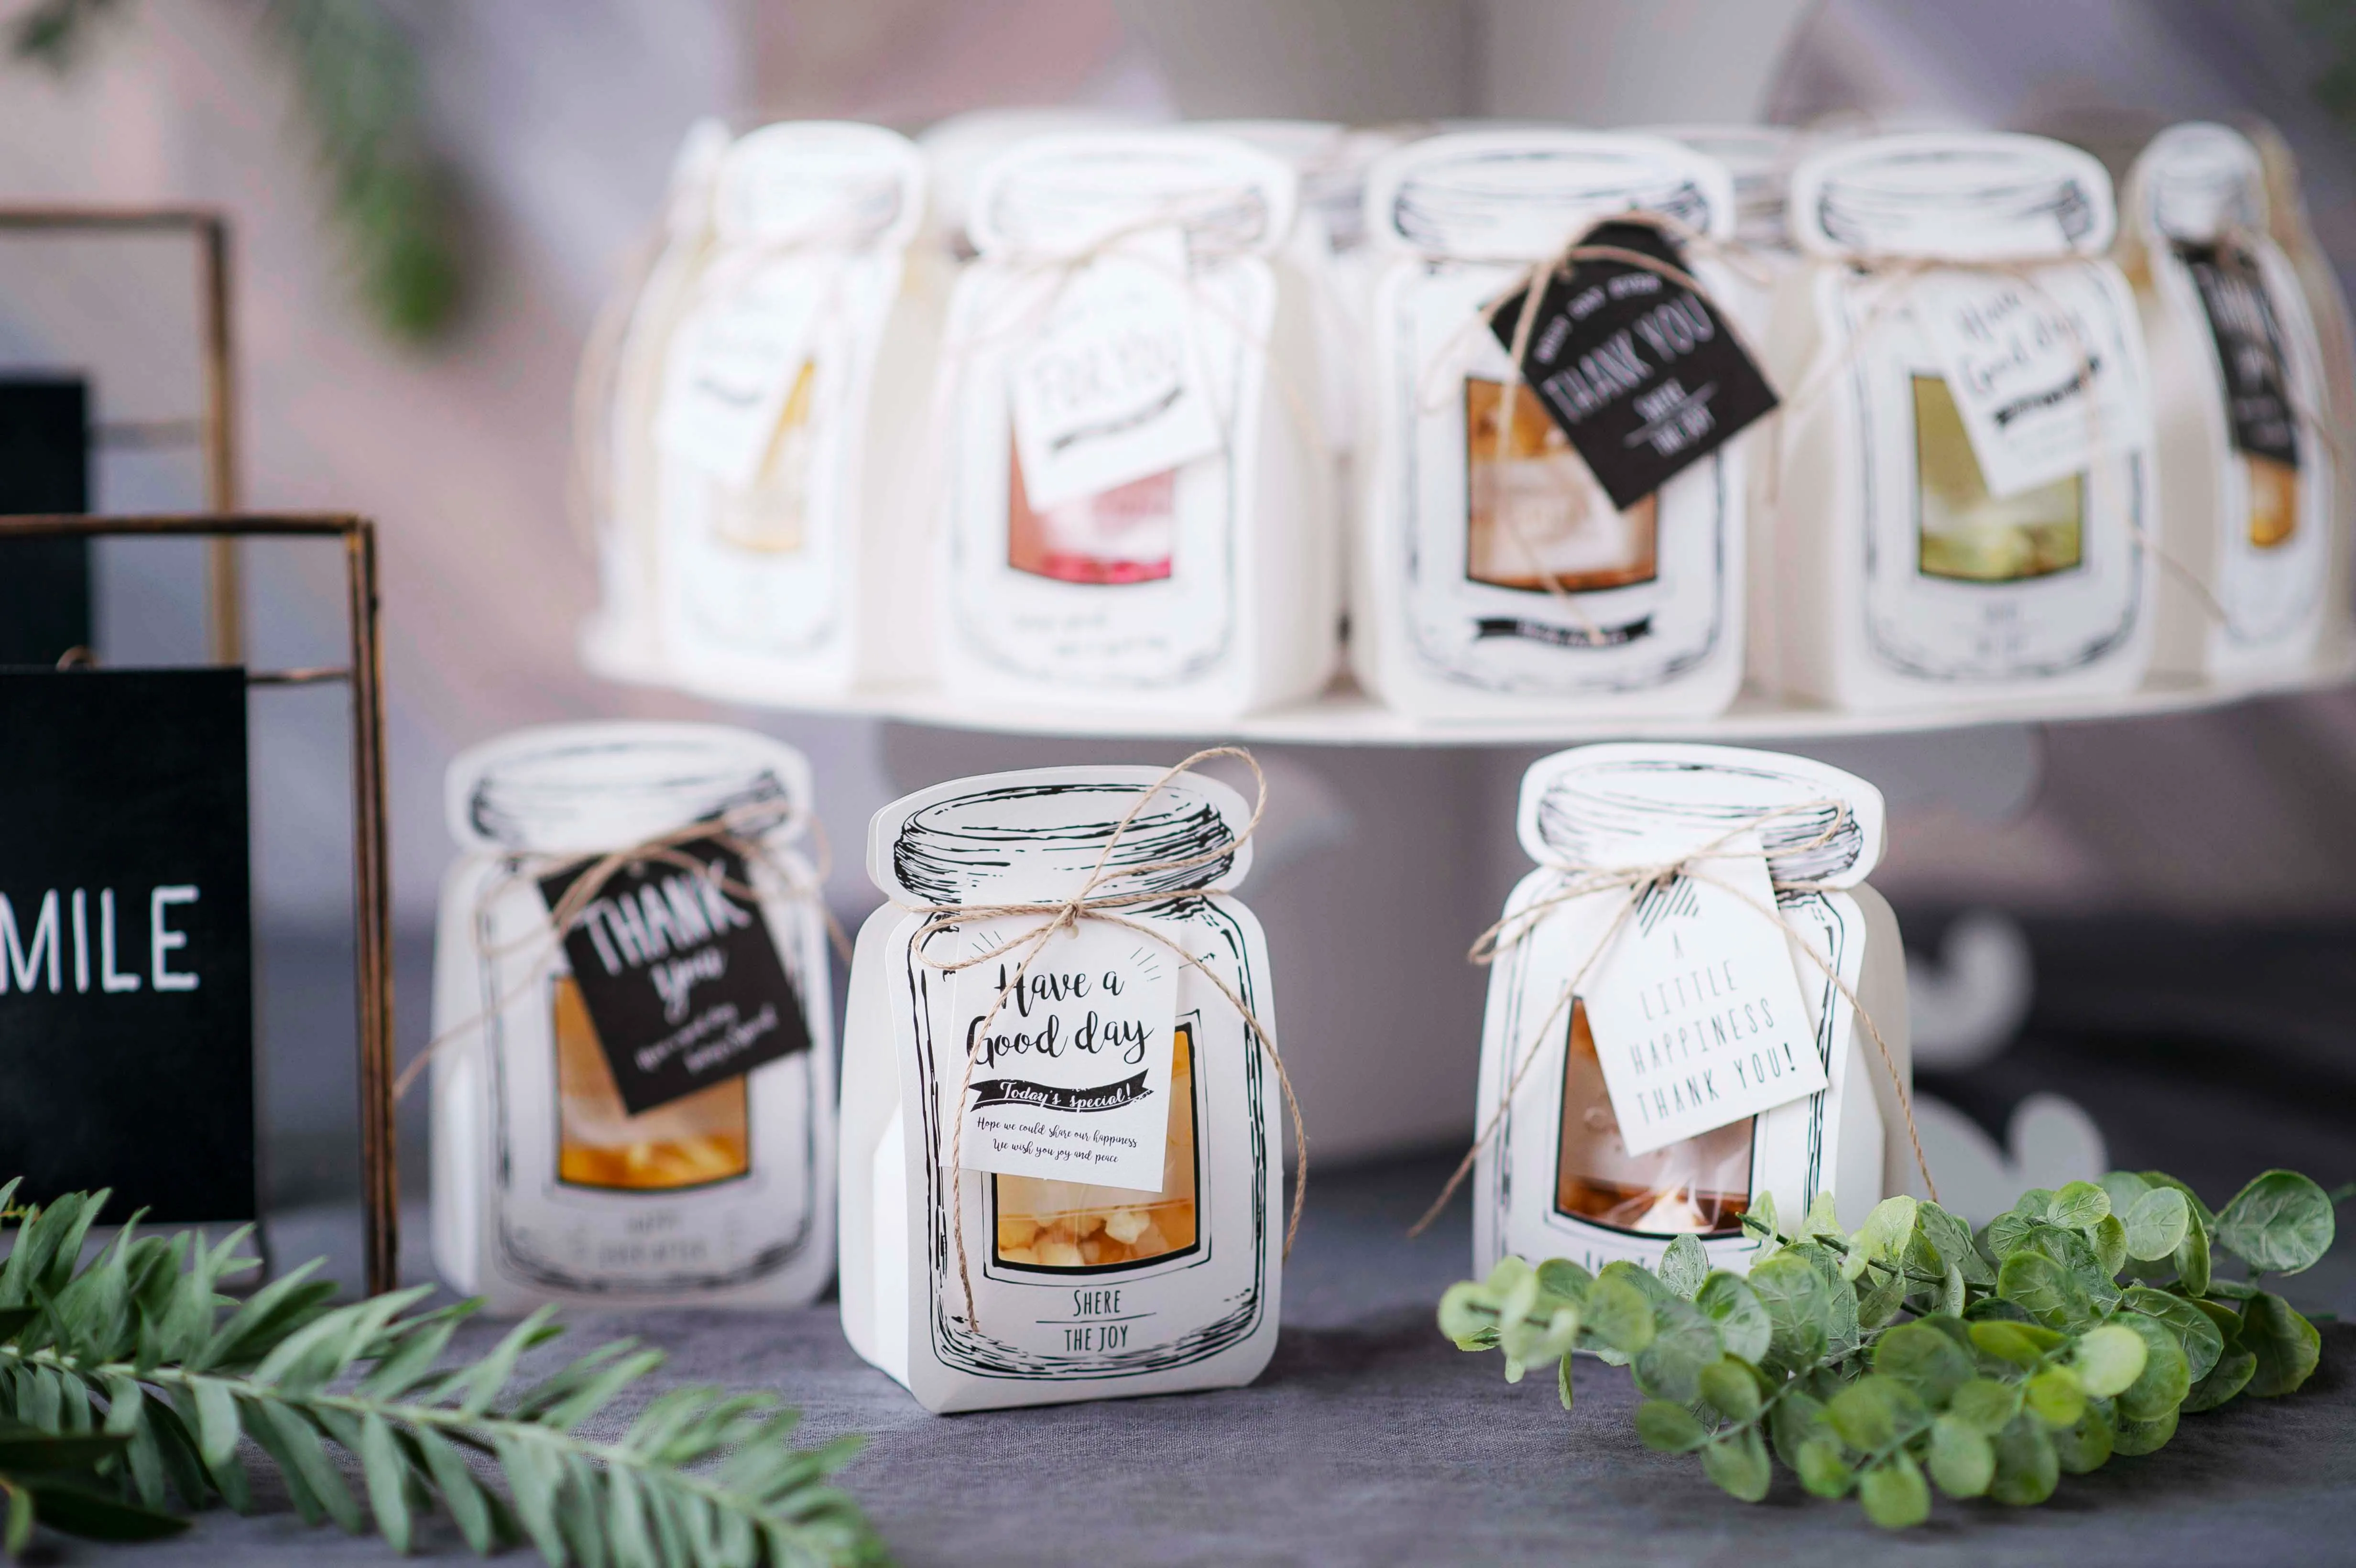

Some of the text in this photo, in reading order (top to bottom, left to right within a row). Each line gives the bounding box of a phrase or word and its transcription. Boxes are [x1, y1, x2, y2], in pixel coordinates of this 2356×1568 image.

[1633, 290, 1714, 363] YOU
[573, 859, 751, 976] THANK
[994, 962, 1124, 1017] Have a
[1640, 958, 1738, 1021] LITTLE
[966, 1011, 1155, 1069] Good day
[1630, 997, 1774, 1076] HAPPINESS
[1000, 1081, 1132, 1113] Today's special!
[1637, 1042, 1796, 1125] THANK YOU!
[977, 1116, 1137, 1148] Hope we could share our happiness
[993, 1139, 1119, 1164] We wish you joy and peace
[1073, 1289, 1121, 1317] SHERE
[1064, 1325, 1128, 1352] THE JOY
